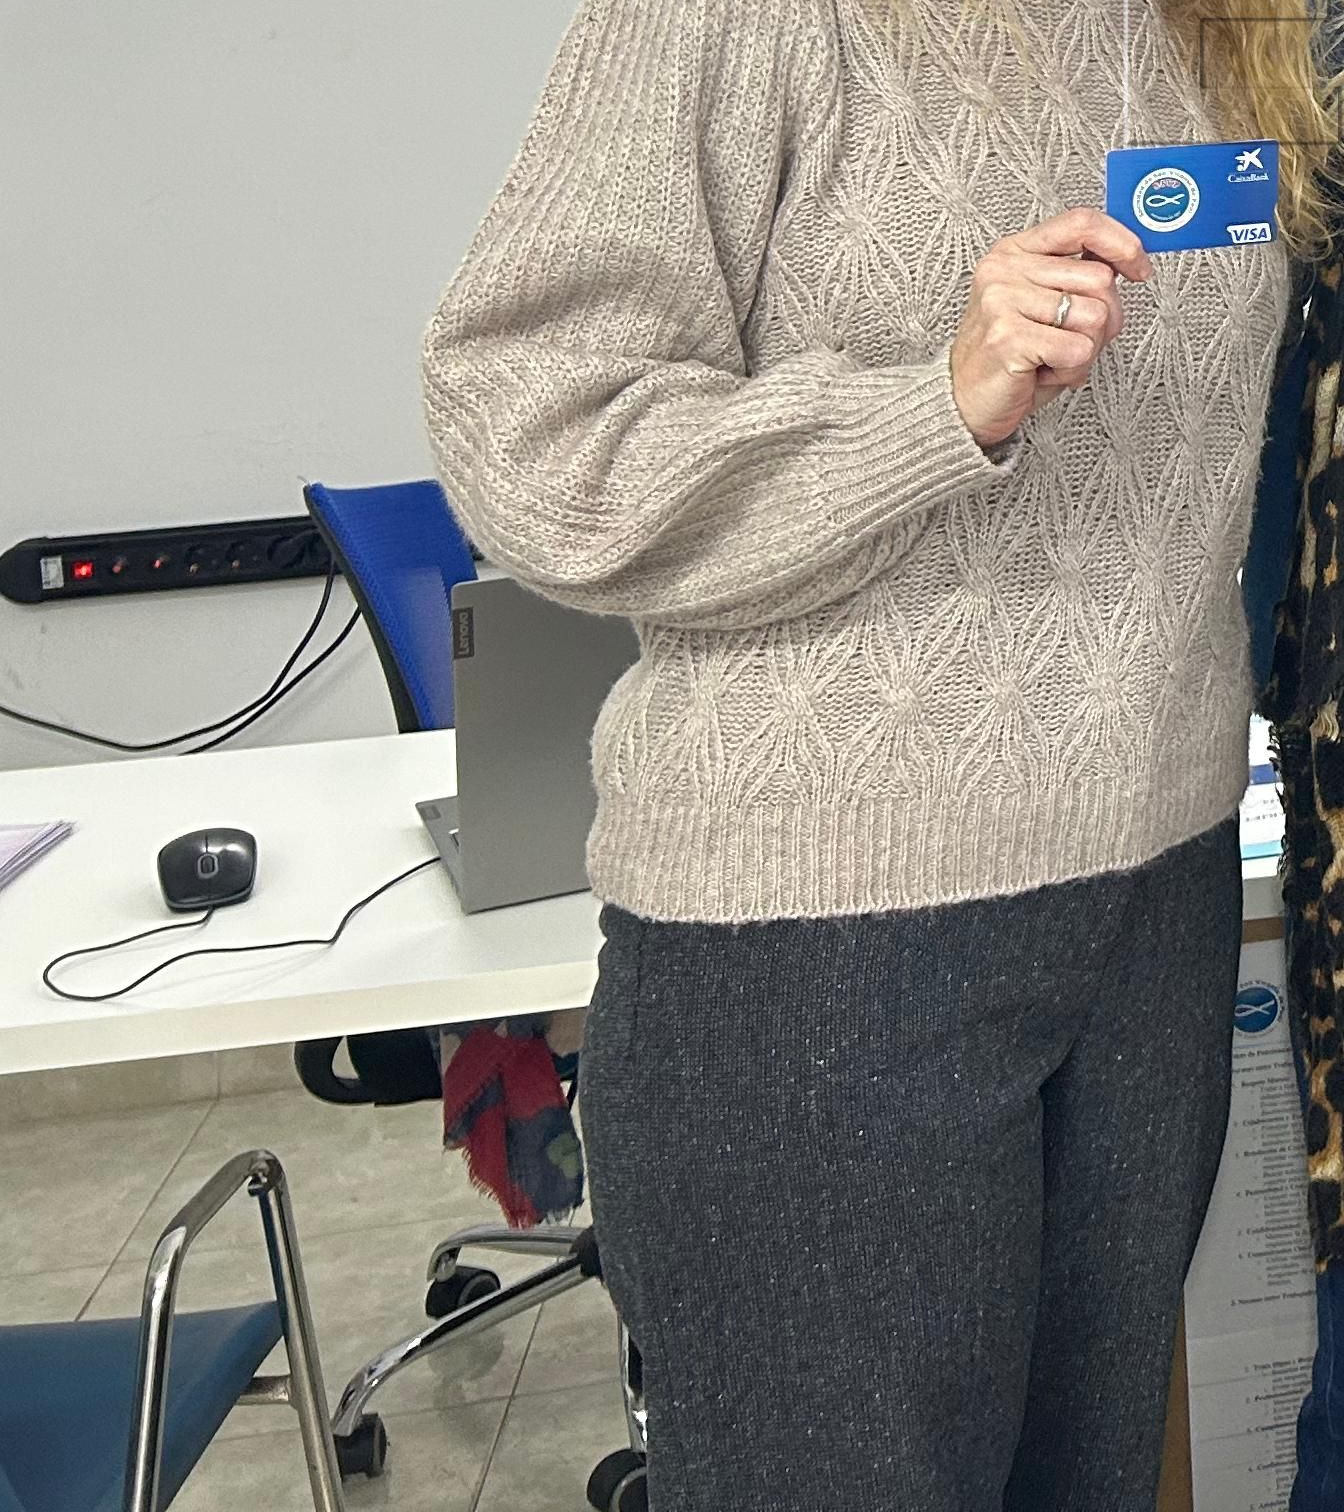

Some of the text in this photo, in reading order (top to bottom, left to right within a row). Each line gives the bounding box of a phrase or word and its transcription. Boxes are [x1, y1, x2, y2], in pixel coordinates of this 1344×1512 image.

[1227, 173, 1270, 183] CaixaBank
[1232, 227, 1269, 242] VISA
[458, 612, 469, 655] Lenovo
